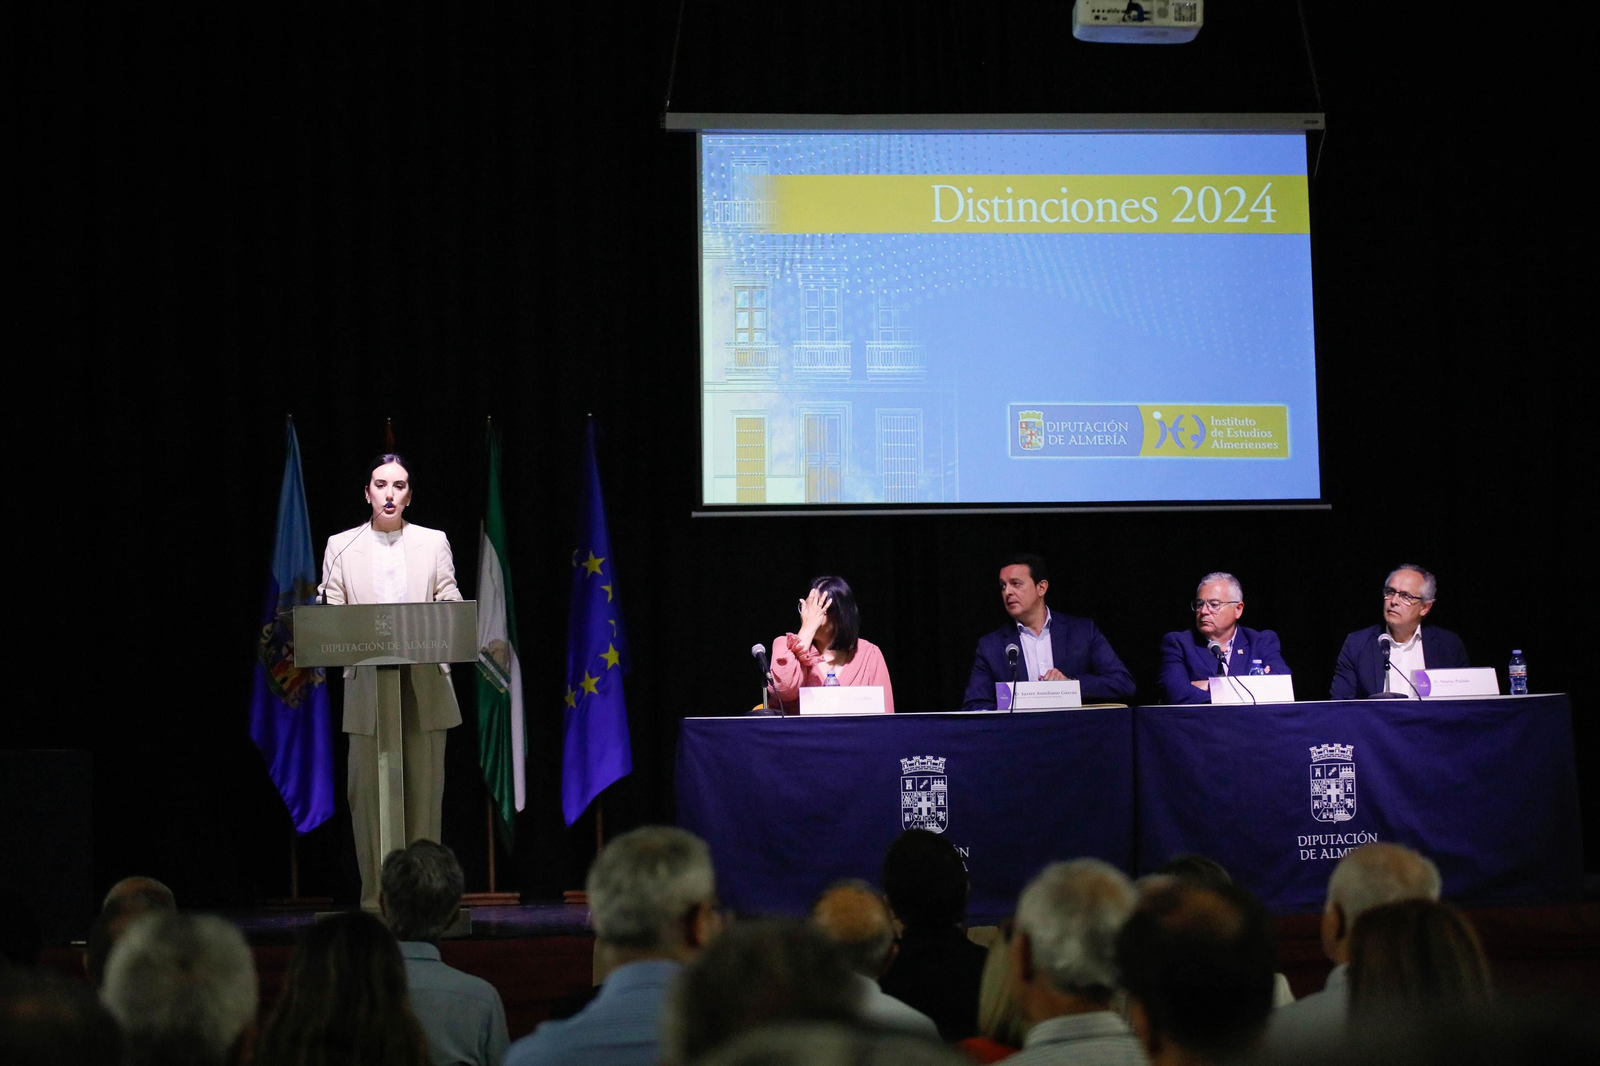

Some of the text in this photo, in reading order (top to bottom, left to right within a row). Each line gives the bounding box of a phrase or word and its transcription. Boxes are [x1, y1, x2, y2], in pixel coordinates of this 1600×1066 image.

[931, 182, 1277, 223] Distinciones 2024
[1046, 420, 1129, 433] DIPUTACIÓN
[1210, 416, 1256, 427] Instituto
[1211, 428, 1273, 438] de Estudios
[1048, 433, 1128, 446] DE ALMERÍA
[1211, 439, 1279, 449] Almerienses
[321, 641, 385, 653] DIPUTACIÓN
[387, 642, 400, 650] DE
[1297, 830, 1378, 847] DIPUTACIÓN
[1300, 849, 1317, 860] DE
